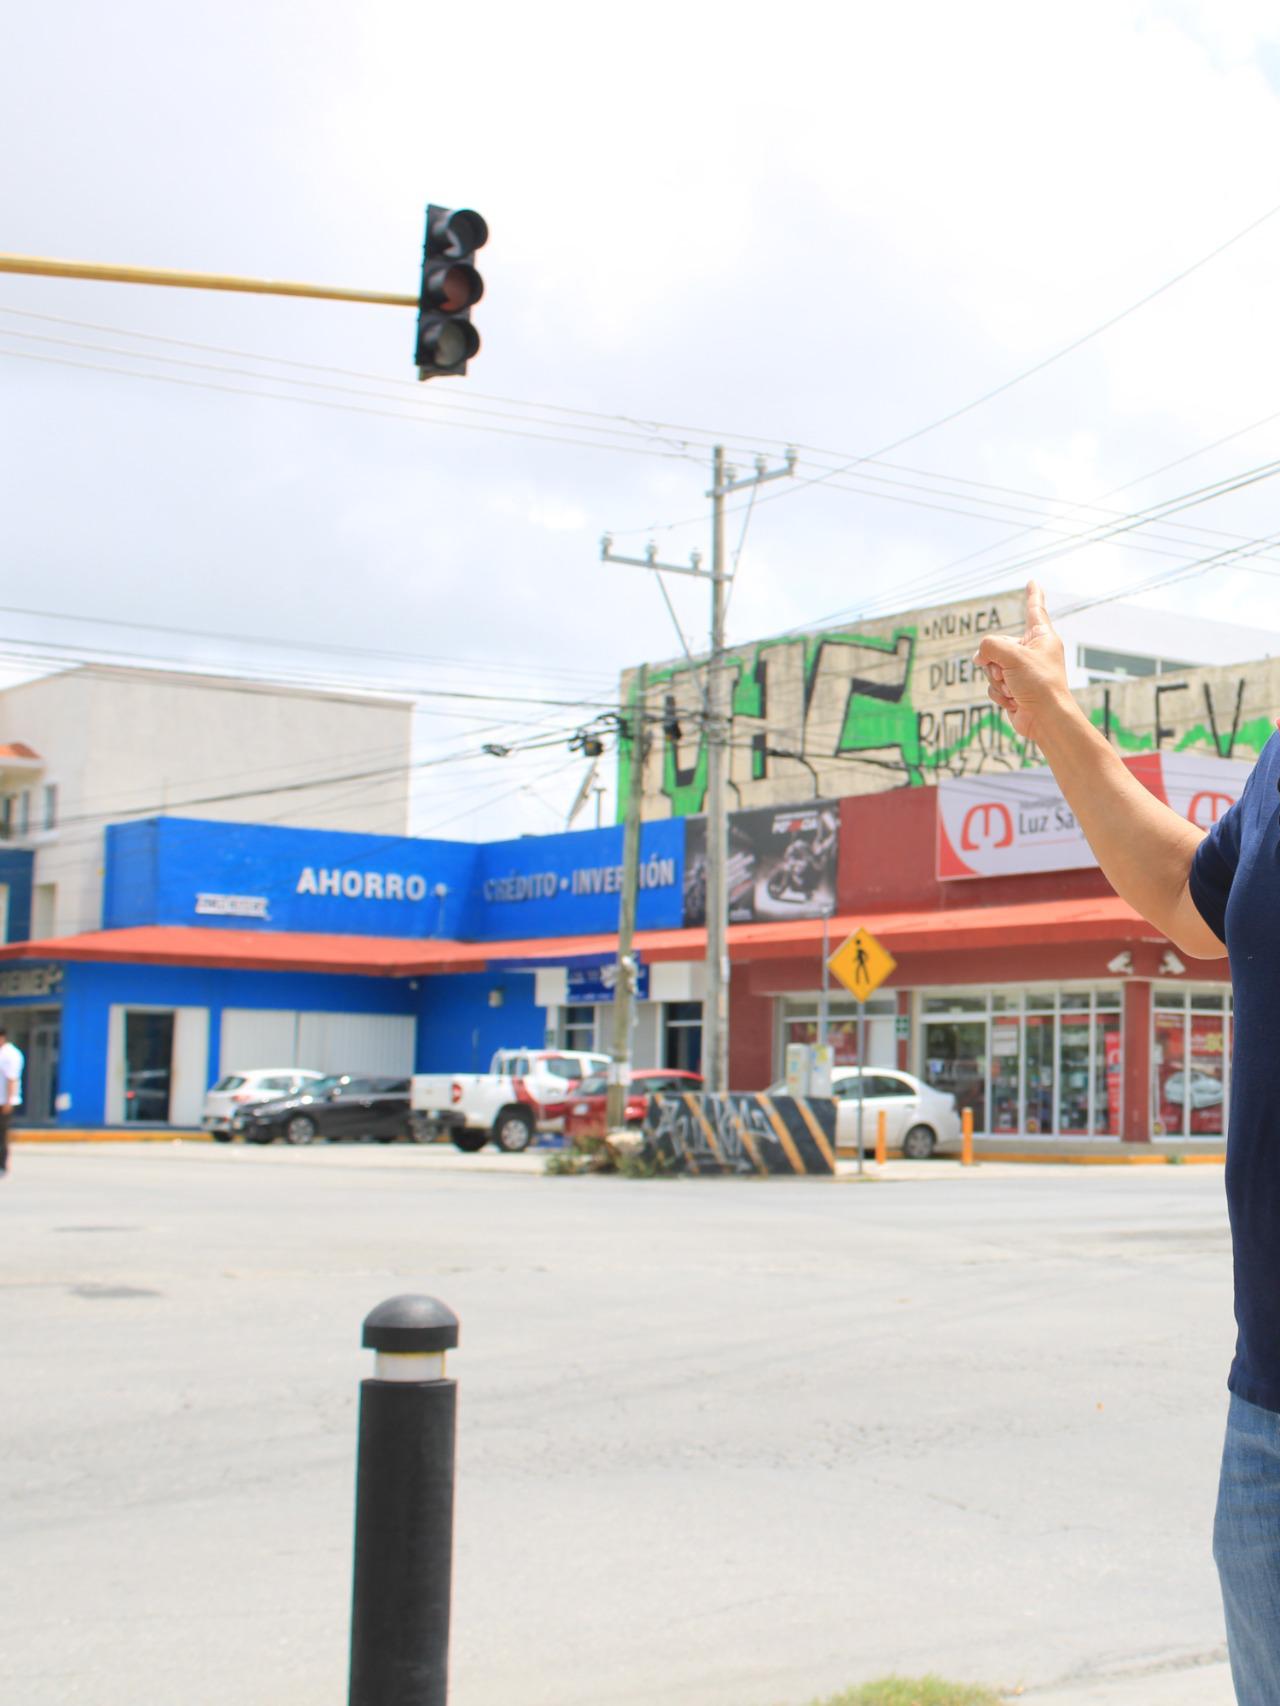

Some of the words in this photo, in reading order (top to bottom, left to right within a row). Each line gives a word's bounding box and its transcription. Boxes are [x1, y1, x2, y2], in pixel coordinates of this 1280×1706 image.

[1019, 812, 1049, 835] Luz
[297, 866, 426, 901] AHORRO
[572, 853, 674, 895] INVERIÓN
